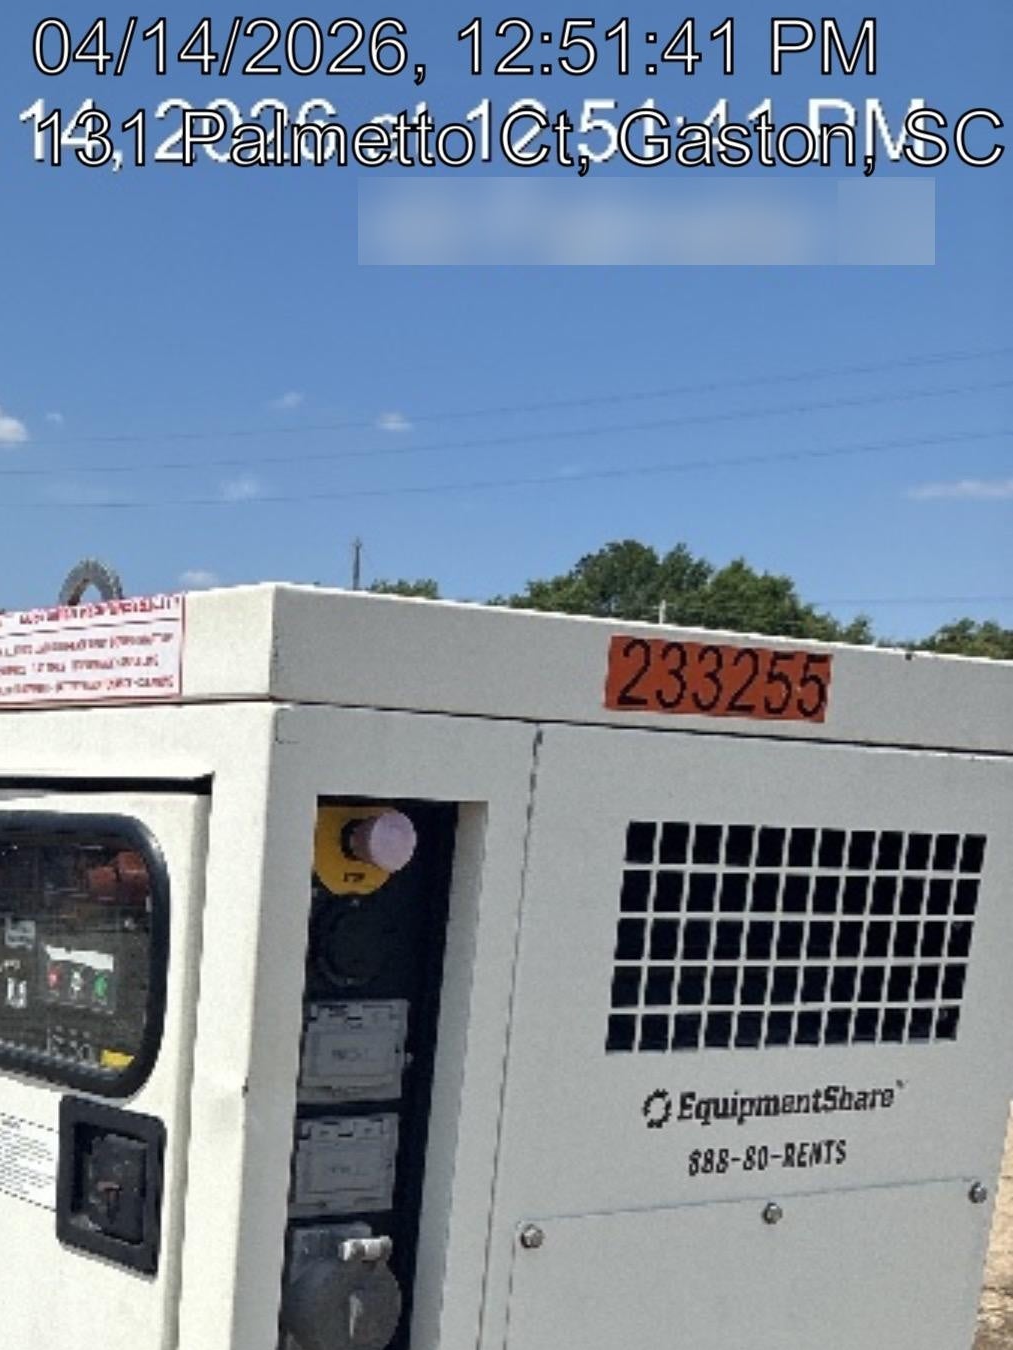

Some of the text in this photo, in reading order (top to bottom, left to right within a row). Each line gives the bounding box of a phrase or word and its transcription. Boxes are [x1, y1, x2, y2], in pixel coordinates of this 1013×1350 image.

[617, 638, 829, 717] 233255
[677, 1085, 895, 1126] EquipmentShare
[689, 1139, 848, 1177] 888-80-RENTS
